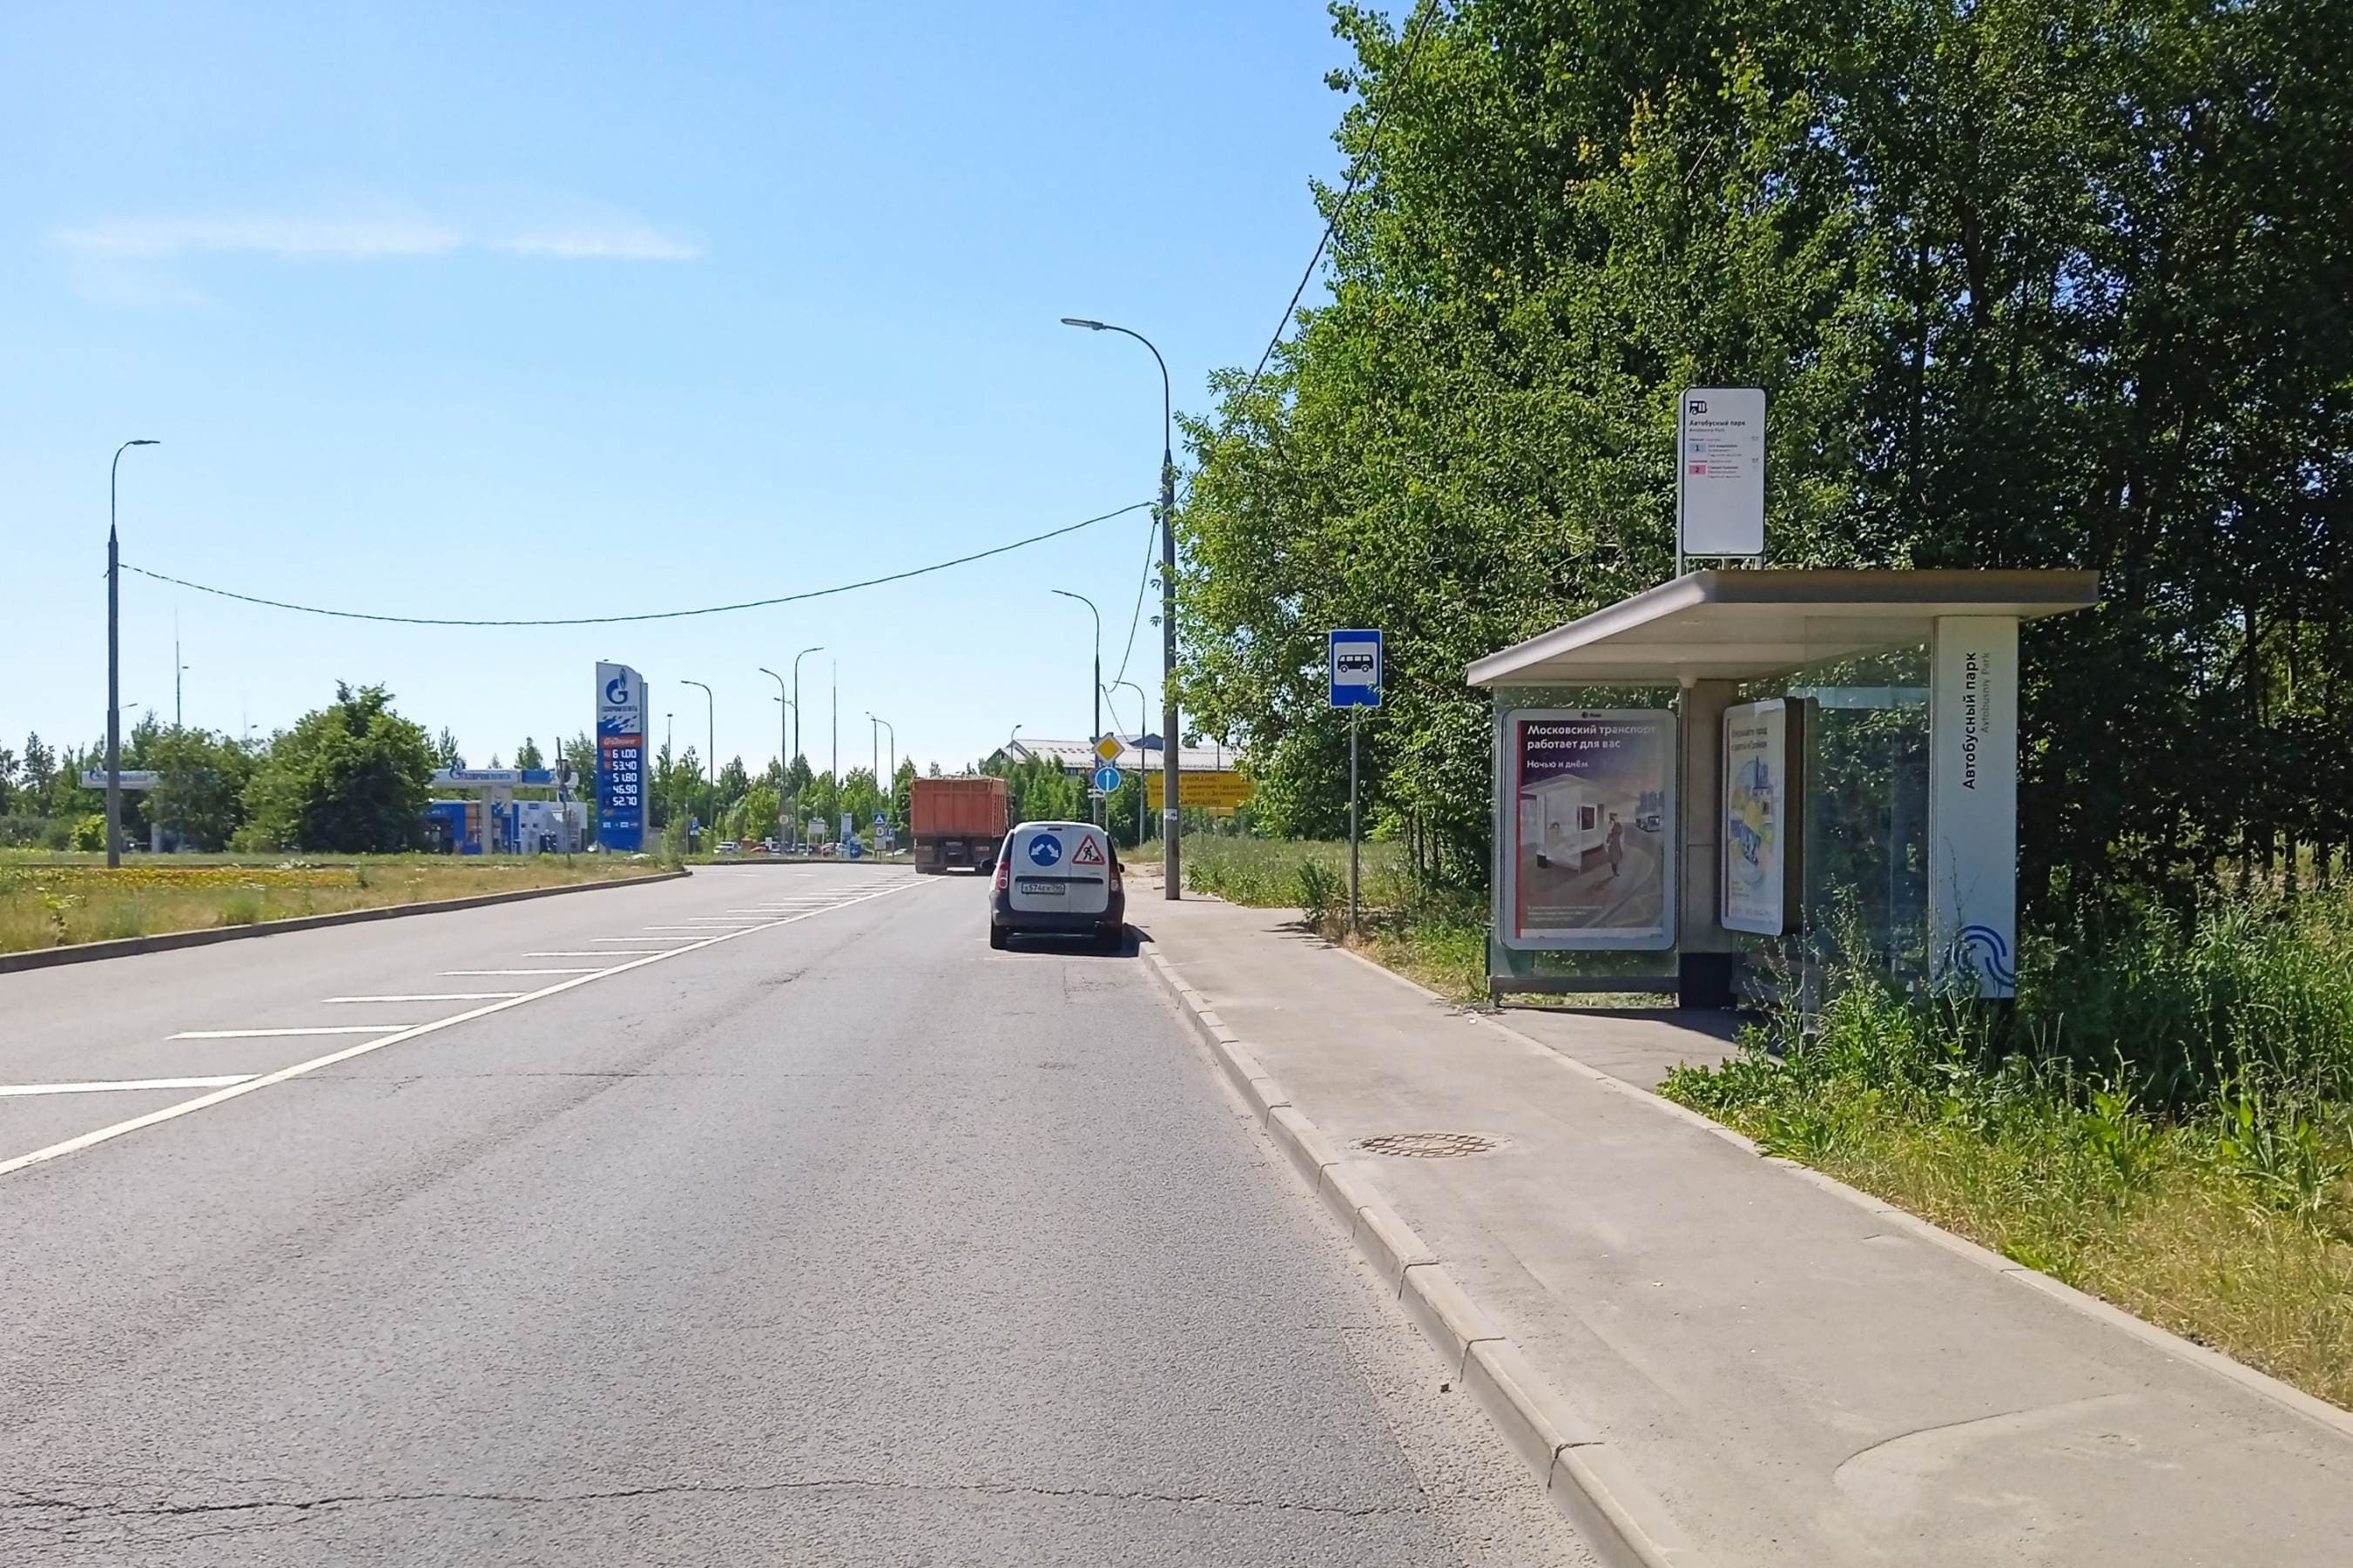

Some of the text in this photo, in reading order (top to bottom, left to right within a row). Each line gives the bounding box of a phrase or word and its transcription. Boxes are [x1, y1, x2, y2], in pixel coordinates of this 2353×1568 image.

[1980, 652, 1991, 676] Park
[1962, 652, 1979, 791] Автобусный парк
[1527, 724, 1656, 737] Московский транспорт
[1527, 738, 1621, 750] работает для вас
[1527, 760, 1556, 769] Ночью
[1565, 760, 1589, 769] днём
